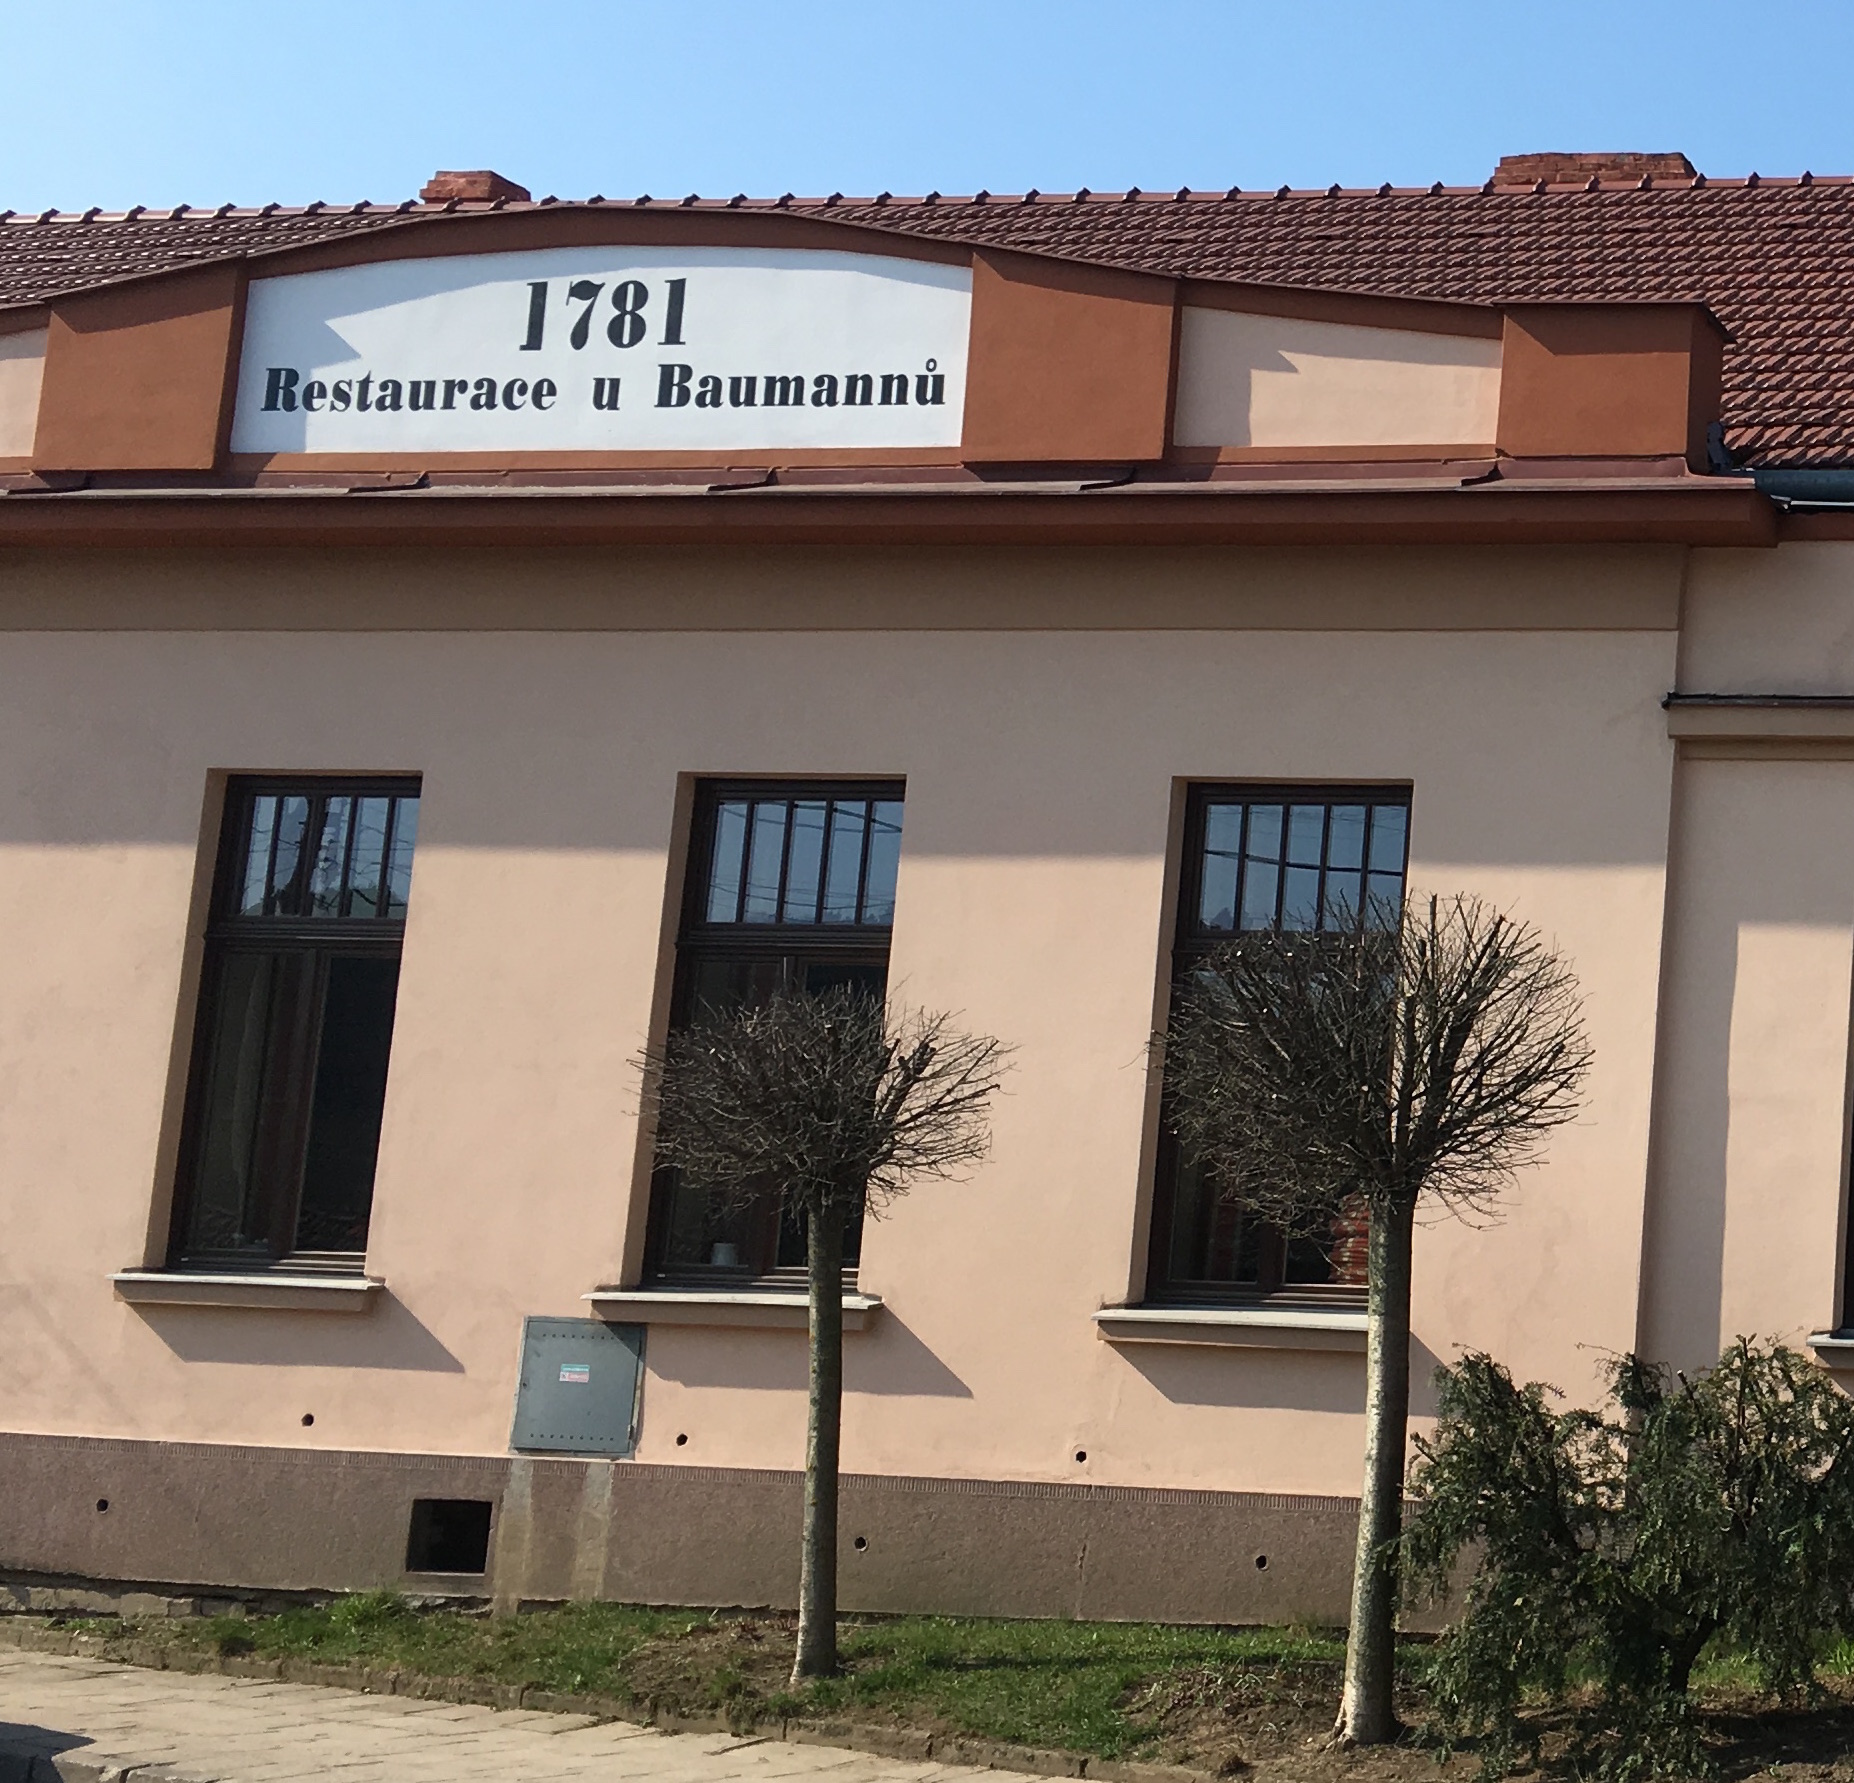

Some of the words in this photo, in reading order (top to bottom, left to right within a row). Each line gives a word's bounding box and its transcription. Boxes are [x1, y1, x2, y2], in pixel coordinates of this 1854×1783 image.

[519, 277, 687, 352] 1781
[260, 367, 557, 412] Restaurace
[592, 378, 621, 411] u
[654, 358, 946, 408] Baumannů
